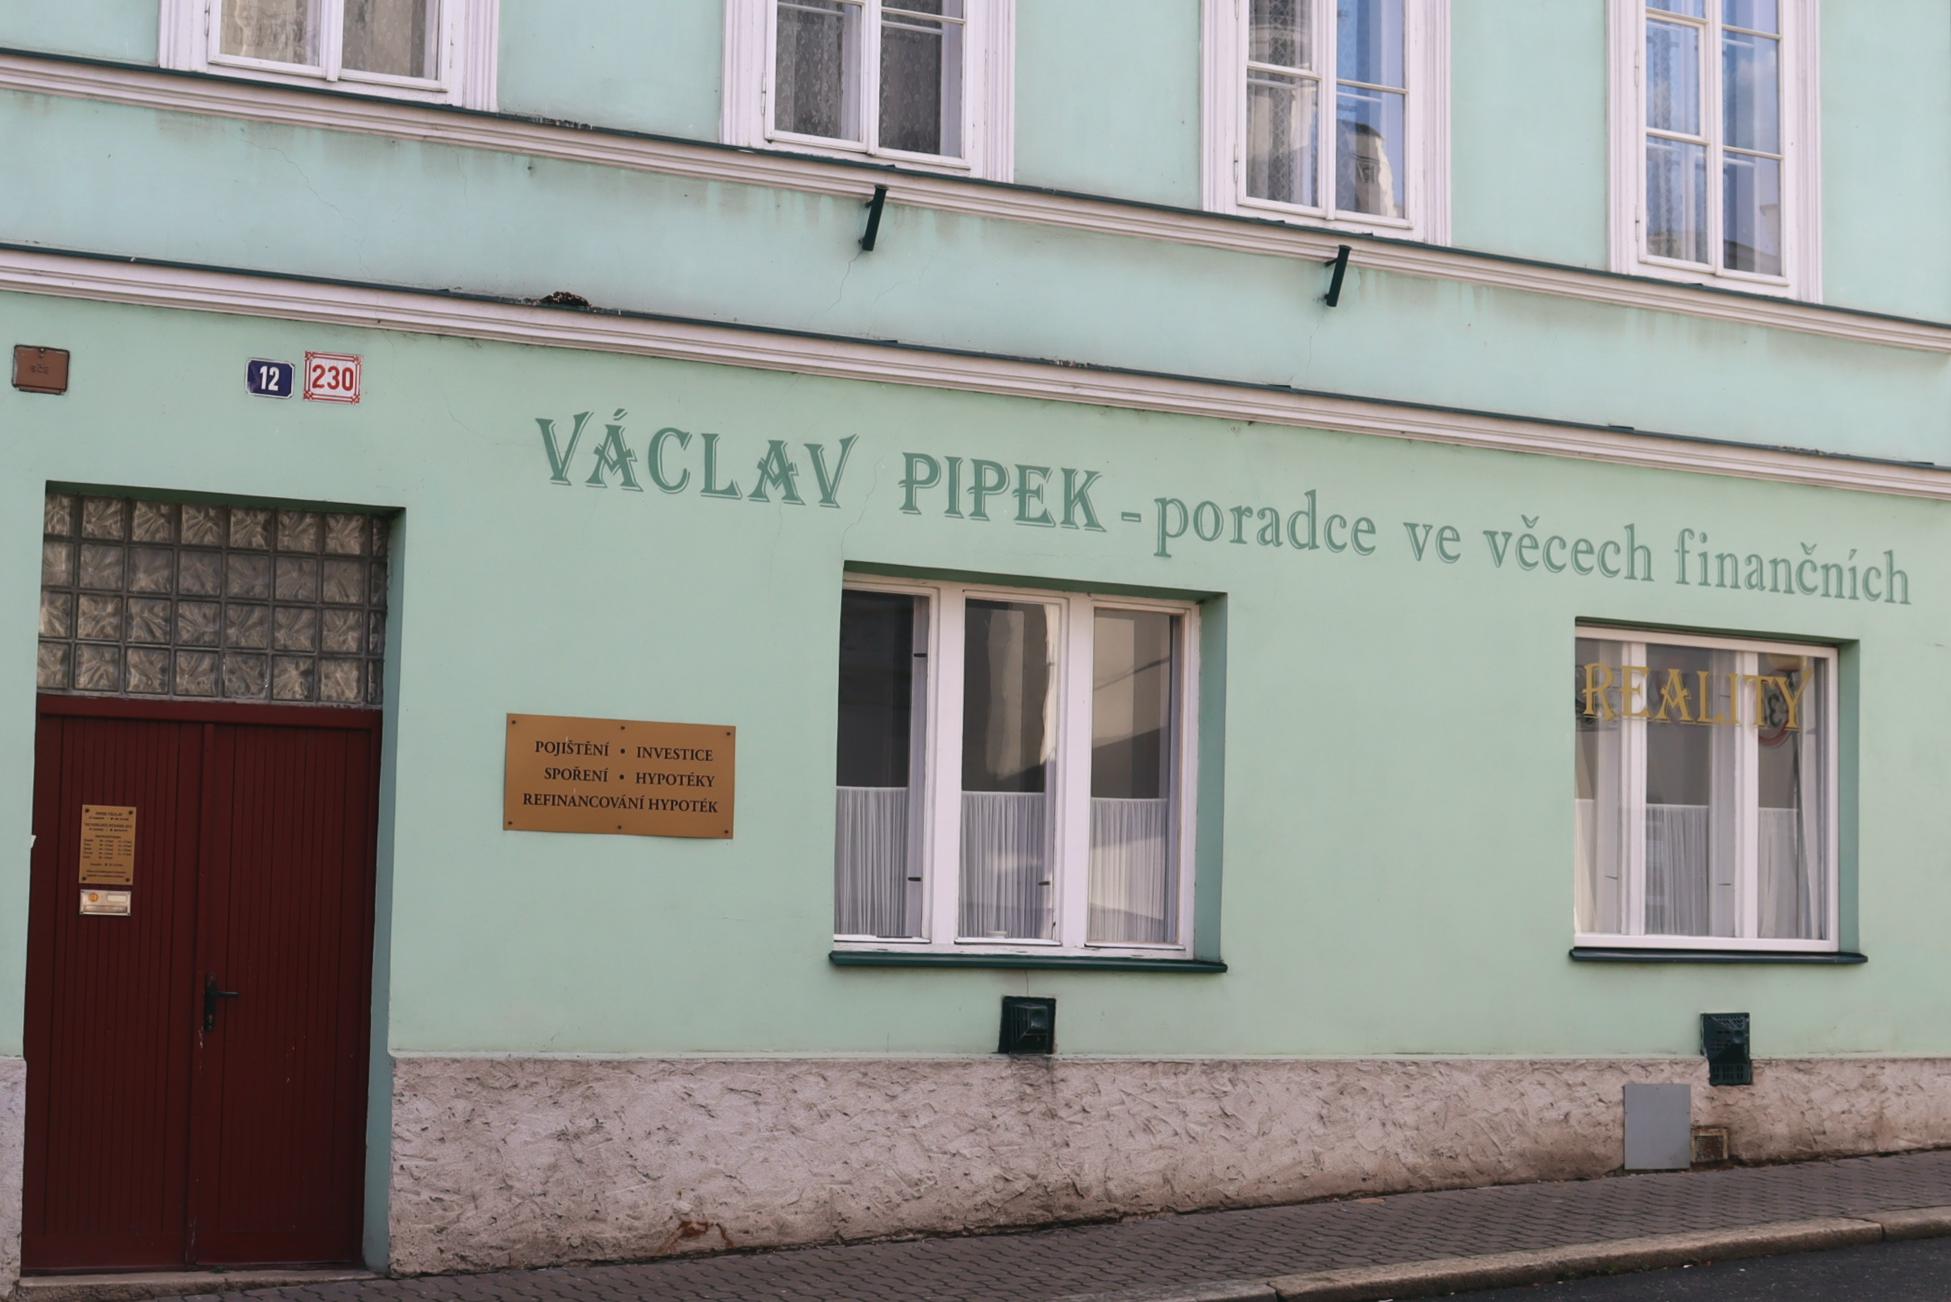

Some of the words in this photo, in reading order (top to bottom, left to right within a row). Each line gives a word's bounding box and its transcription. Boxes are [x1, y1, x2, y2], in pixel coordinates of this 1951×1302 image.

[259, 365, 279, 391] 12
[311, 364, 353, 391] 230
[535, 408, 859, 508] VÁCLAV
[899, 451, 1106, 532] PIPEK
[1404, 521, 1461, 563] ve
[1483, 515, 1655, 582] věcech
[1676, 528, 1912, 605] finančních
[1582, 662, 1812, 731] REALITY
[535, 740, 609, 757] POJIŠTĚNÍ
[636, 746, 713, 761] INVESTICE
[544, 766, 608, 783] SPOŘENÍ
[636, 772, 715, 788] HYPOTÉKY
[523, 793, 644, 810] REFINANCOVÁNÍ
[648, 797, 718, 813] HYPOTÉK
